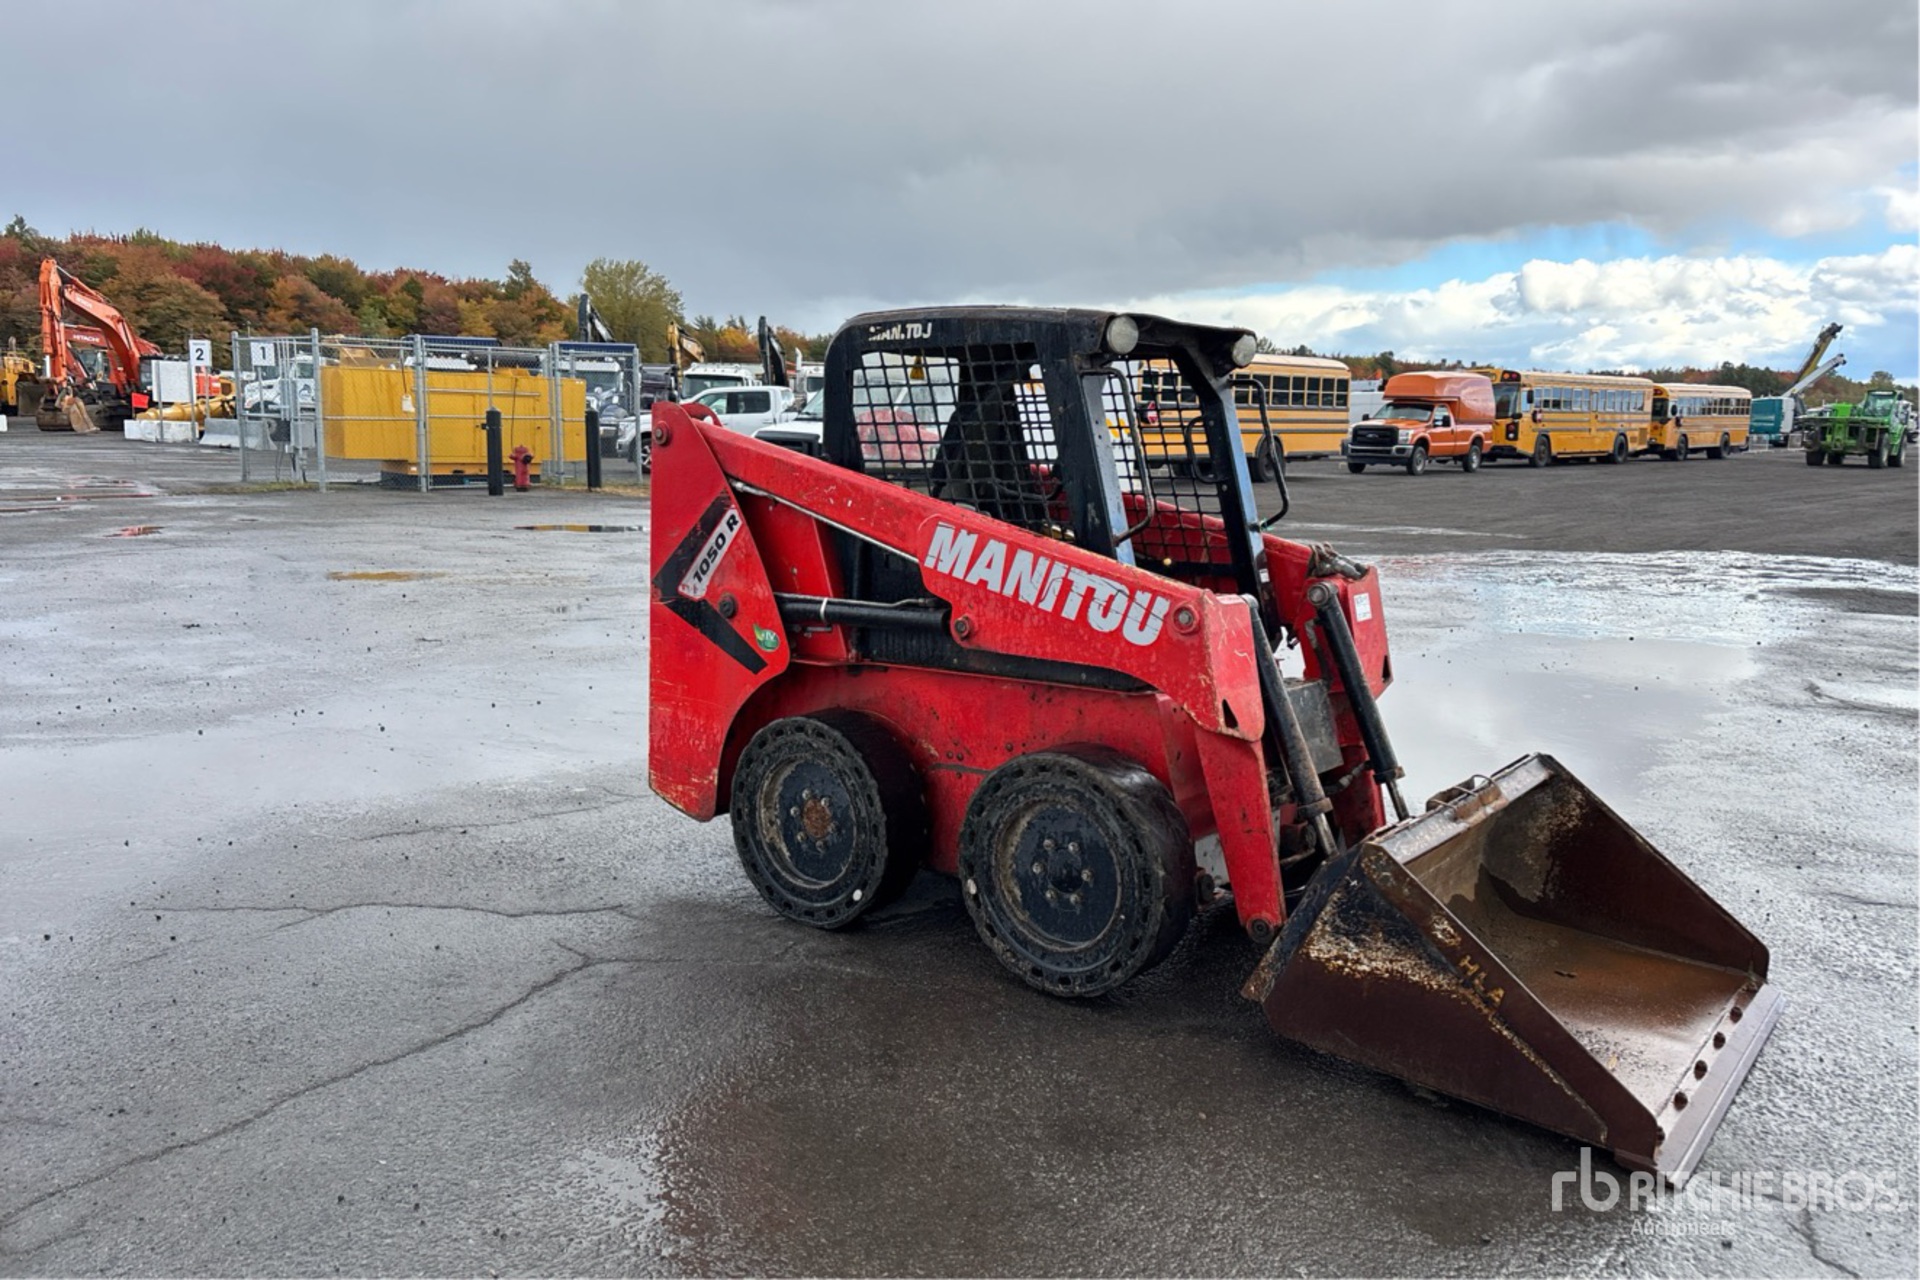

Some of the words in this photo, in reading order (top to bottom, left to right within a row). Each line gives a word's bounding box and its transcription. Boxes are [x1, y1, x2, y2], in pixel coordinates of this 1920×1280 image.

[195, 347, 205, 361] 2
[259, 346, 267, 360] 1
[693, 532, 726, 584] 1050
[726, 513, 739, 533] R
[923, 521, 1171, 647] MANITOU
